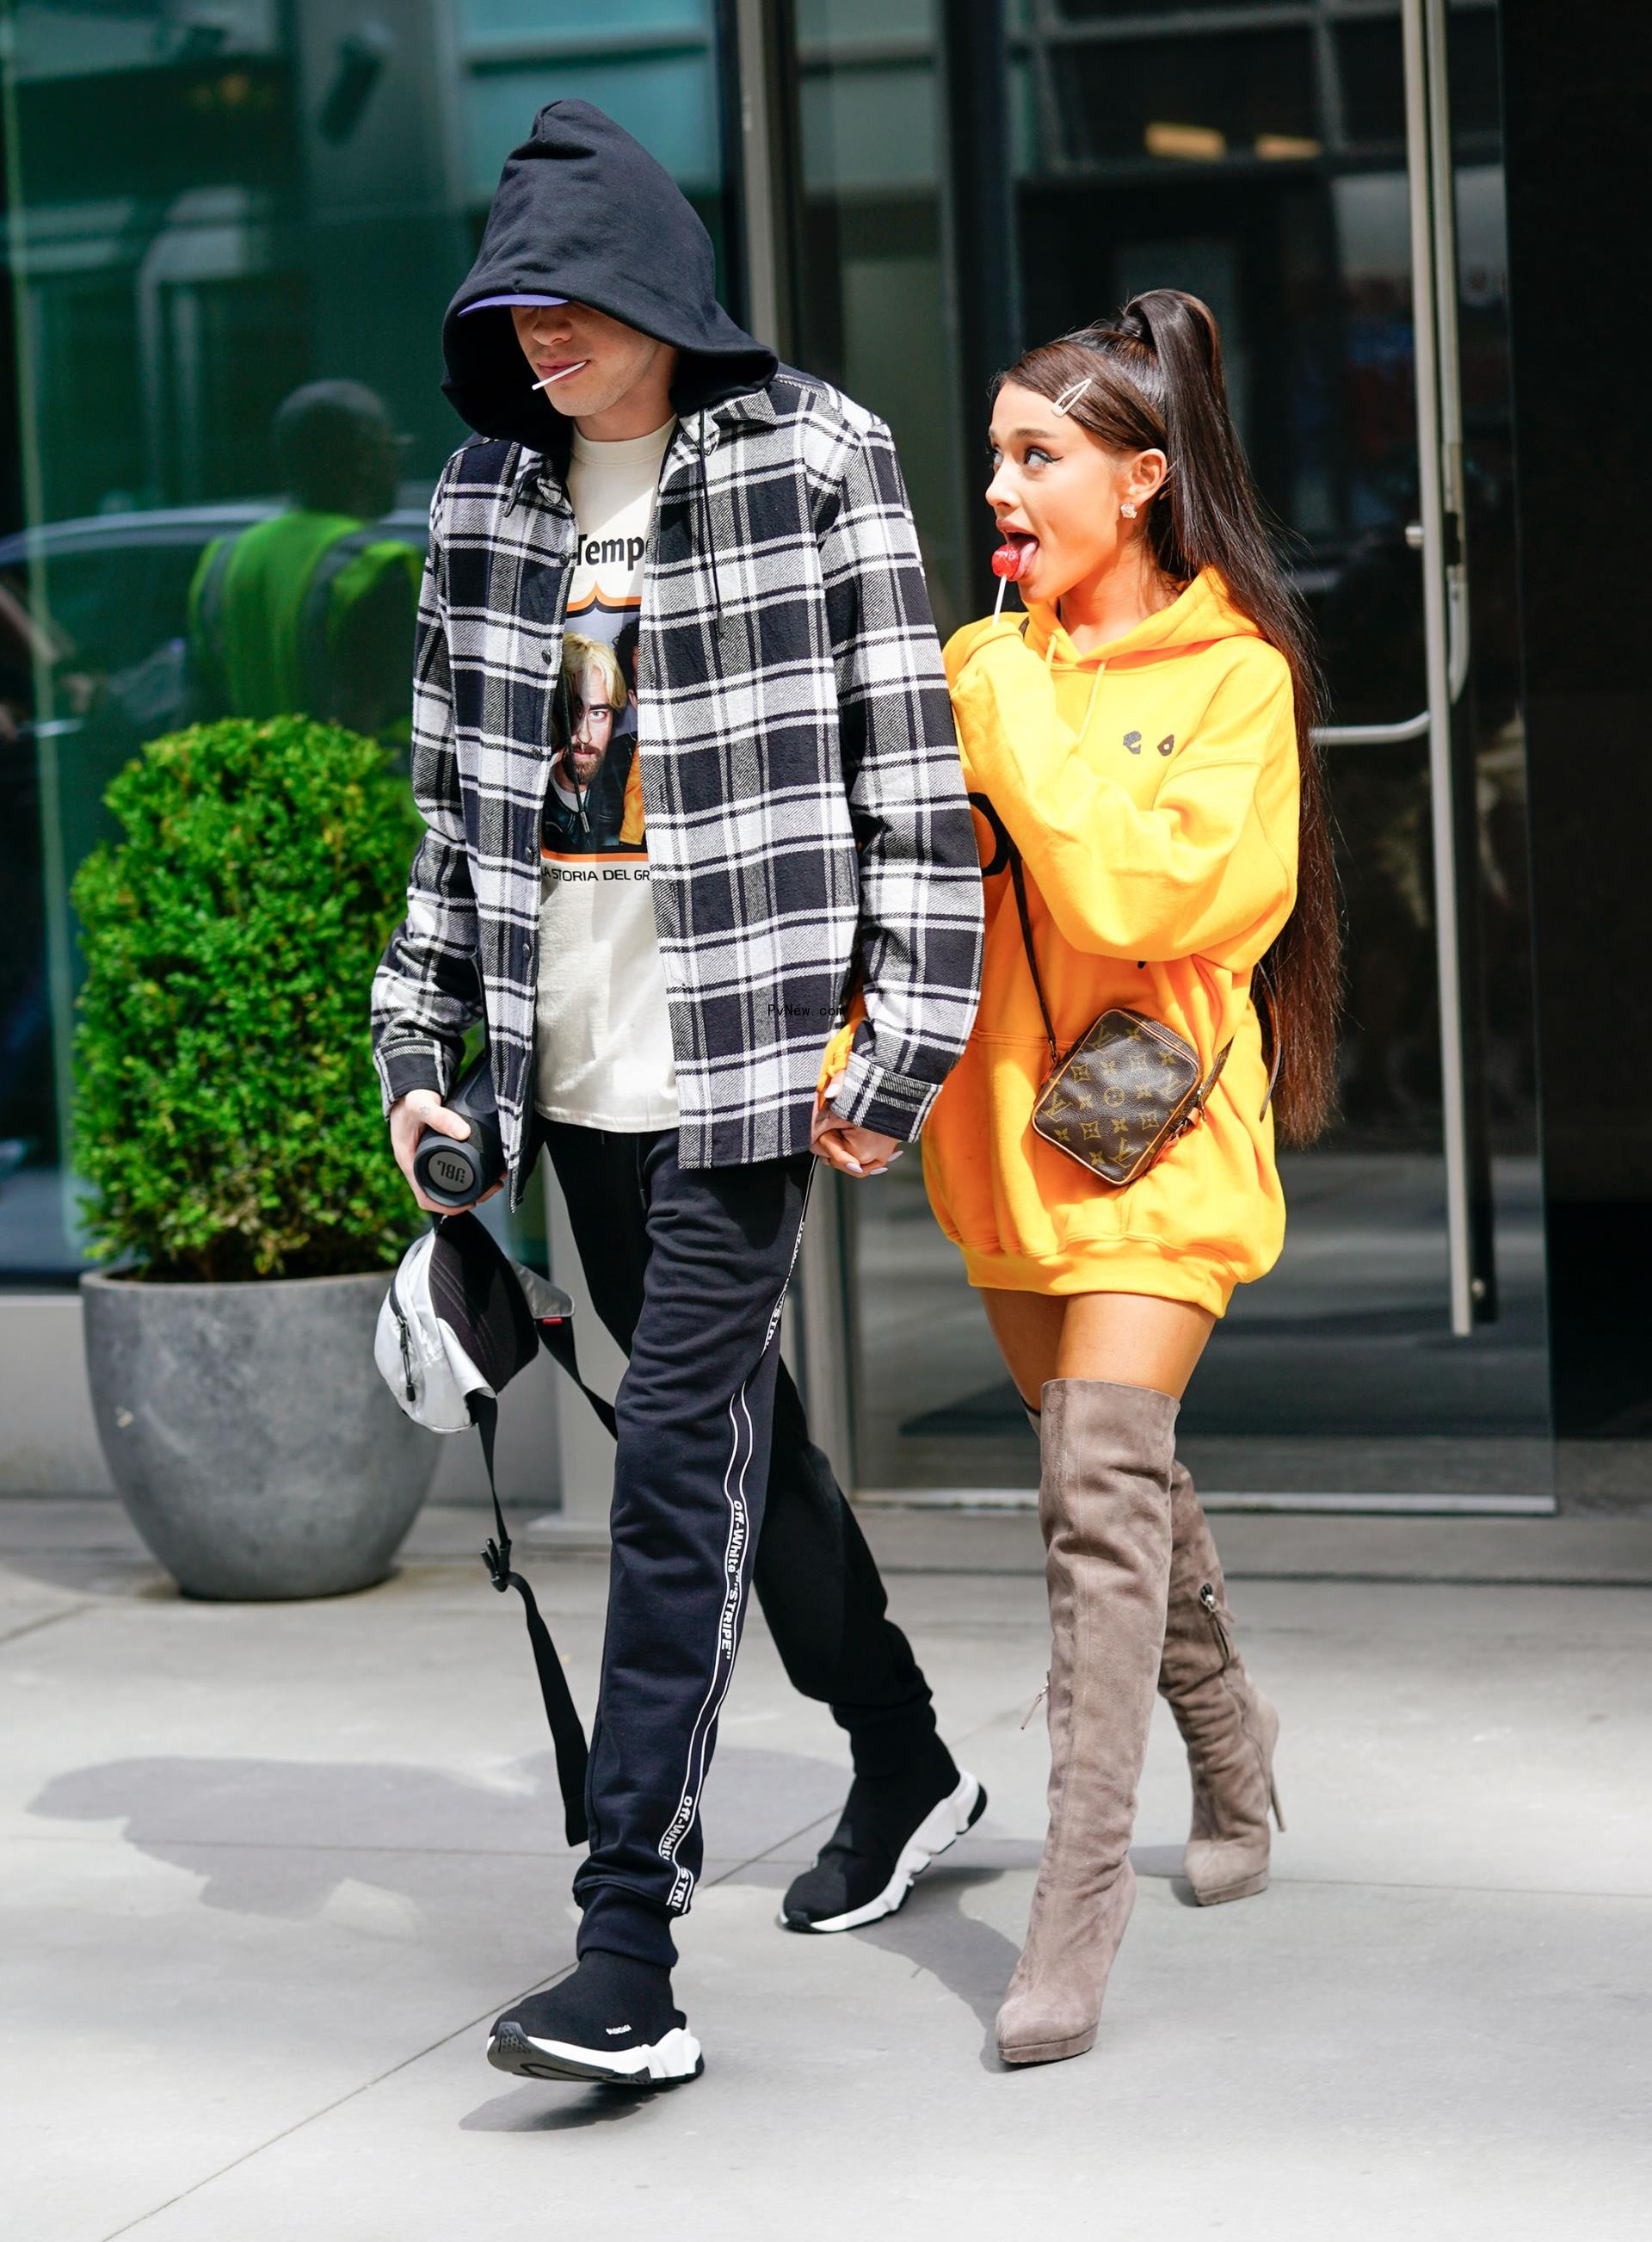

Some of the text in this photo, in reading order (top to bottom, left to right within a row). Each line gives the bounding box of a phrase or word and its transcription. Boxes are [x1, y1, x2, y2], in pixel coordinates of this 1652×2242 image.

[576, 534, 650, 571] Temp
[552, 868, 599, 881] STORIA
[602, 869, 632, 881] DEL
[634, 869, 650, 881] GR
[436, 1160, 465, 1184] JBL
[670, 1868, 690, 1910] STRI
